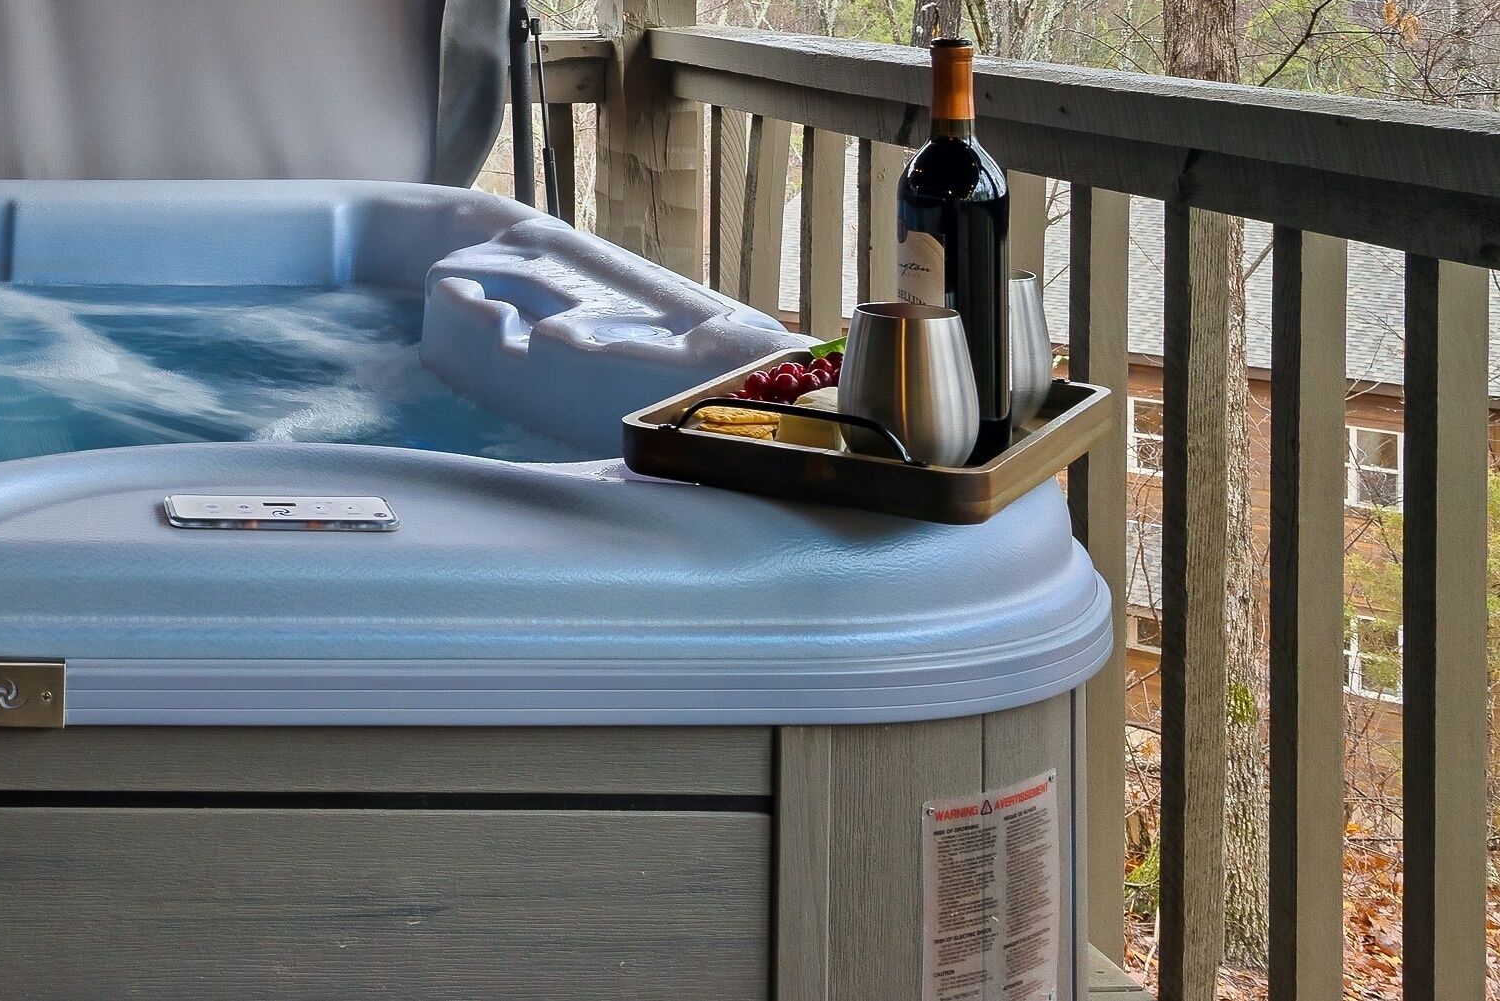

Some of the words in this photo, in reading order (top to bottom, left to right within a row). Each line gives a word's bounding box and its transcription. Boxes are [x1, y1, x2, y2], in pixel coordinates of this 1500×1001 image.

[934, 805, 979, 821] WARNING
[994, 781, 1048, 810] AVERTISSEMENT
[933, 970, 955, 978] CAUTION
